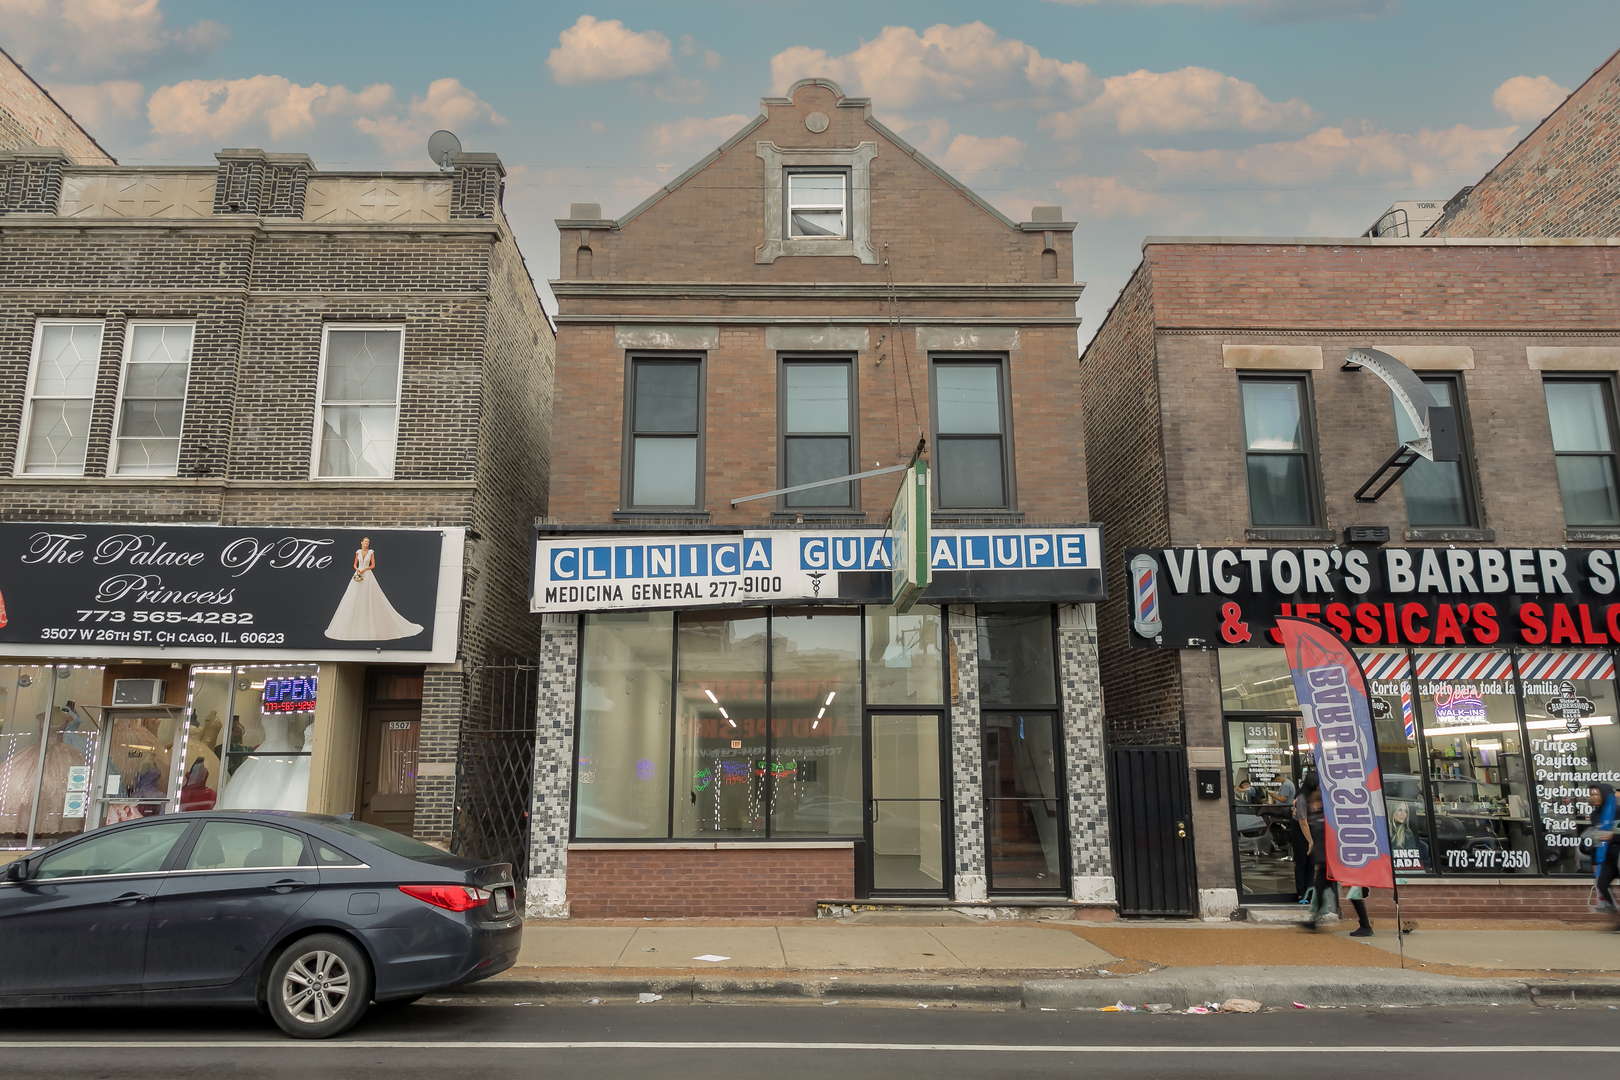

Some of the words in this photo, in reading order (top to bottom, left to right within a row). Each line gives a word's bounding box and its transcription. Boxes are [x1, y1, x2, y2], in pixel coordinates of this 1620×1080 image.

[20, 531, 87, 564] The
[92, 533, 205, 566] Palace
[219, 537, 275, 577] Of
[269, 537, 335, 569] The
[553, 540, 772, 579] CLINICA
[803, 536, 1082, 568] GUAALUPE
[1164, 549, 1371, 595] VICTOR'S
[1385, 549, 1573, 594] BARBER
[1588, 549, 1620, 595] S
[95, 573, 236, 605] Princess
[545, 585, 624, 604] MEDICINA
[631, 582, 703, 601] GENERAL
[709, 576, 782, 598] 277-9100
[76, 610, 126, 623] 773
[132, 610, 254, 625] 565-4282
[1220, 601, 1252, 645] &
[40, 628, 77, 640] 3507
[79, 629, 95, 640] W
[95, 629, 130, 641] 26TH
[132, 630, 153, 642] ST.
[221, 632, 237, 643] IL.
[239, 632, 285, 643] 60623
[266, 679, 317, 702] OPEN
[1372, 681, 1399, 695] Corte
[1400, 681, 1412, 695] de
[1418, 681, 1453, 695] cabello
[1454, 684, 1477, 697] para
[1479, 681, 1503, 695] toda
[1504, 681, 1516, 695] la
[1522, 681, 1560, 698] familia
[1437, 709, 1486, 717] WALK-INS
[1438, 715, 1487, 723] WELCOME
[390, 722, 410, 730] 3507
[1248, 726, 1274, 737] 3513
[1531, 739, 1578, 751] Tintes
[1533, 754, 1589, 769] Rayitos
[1540, 802, 1574, 814] Flat
[1576, 802, 1595, 814] To
[1543, 817, 1577, 830] Fade
[1544, 834, 1582, 847] Blow
[1446, 850, 1531, 868] 773-277-2550
